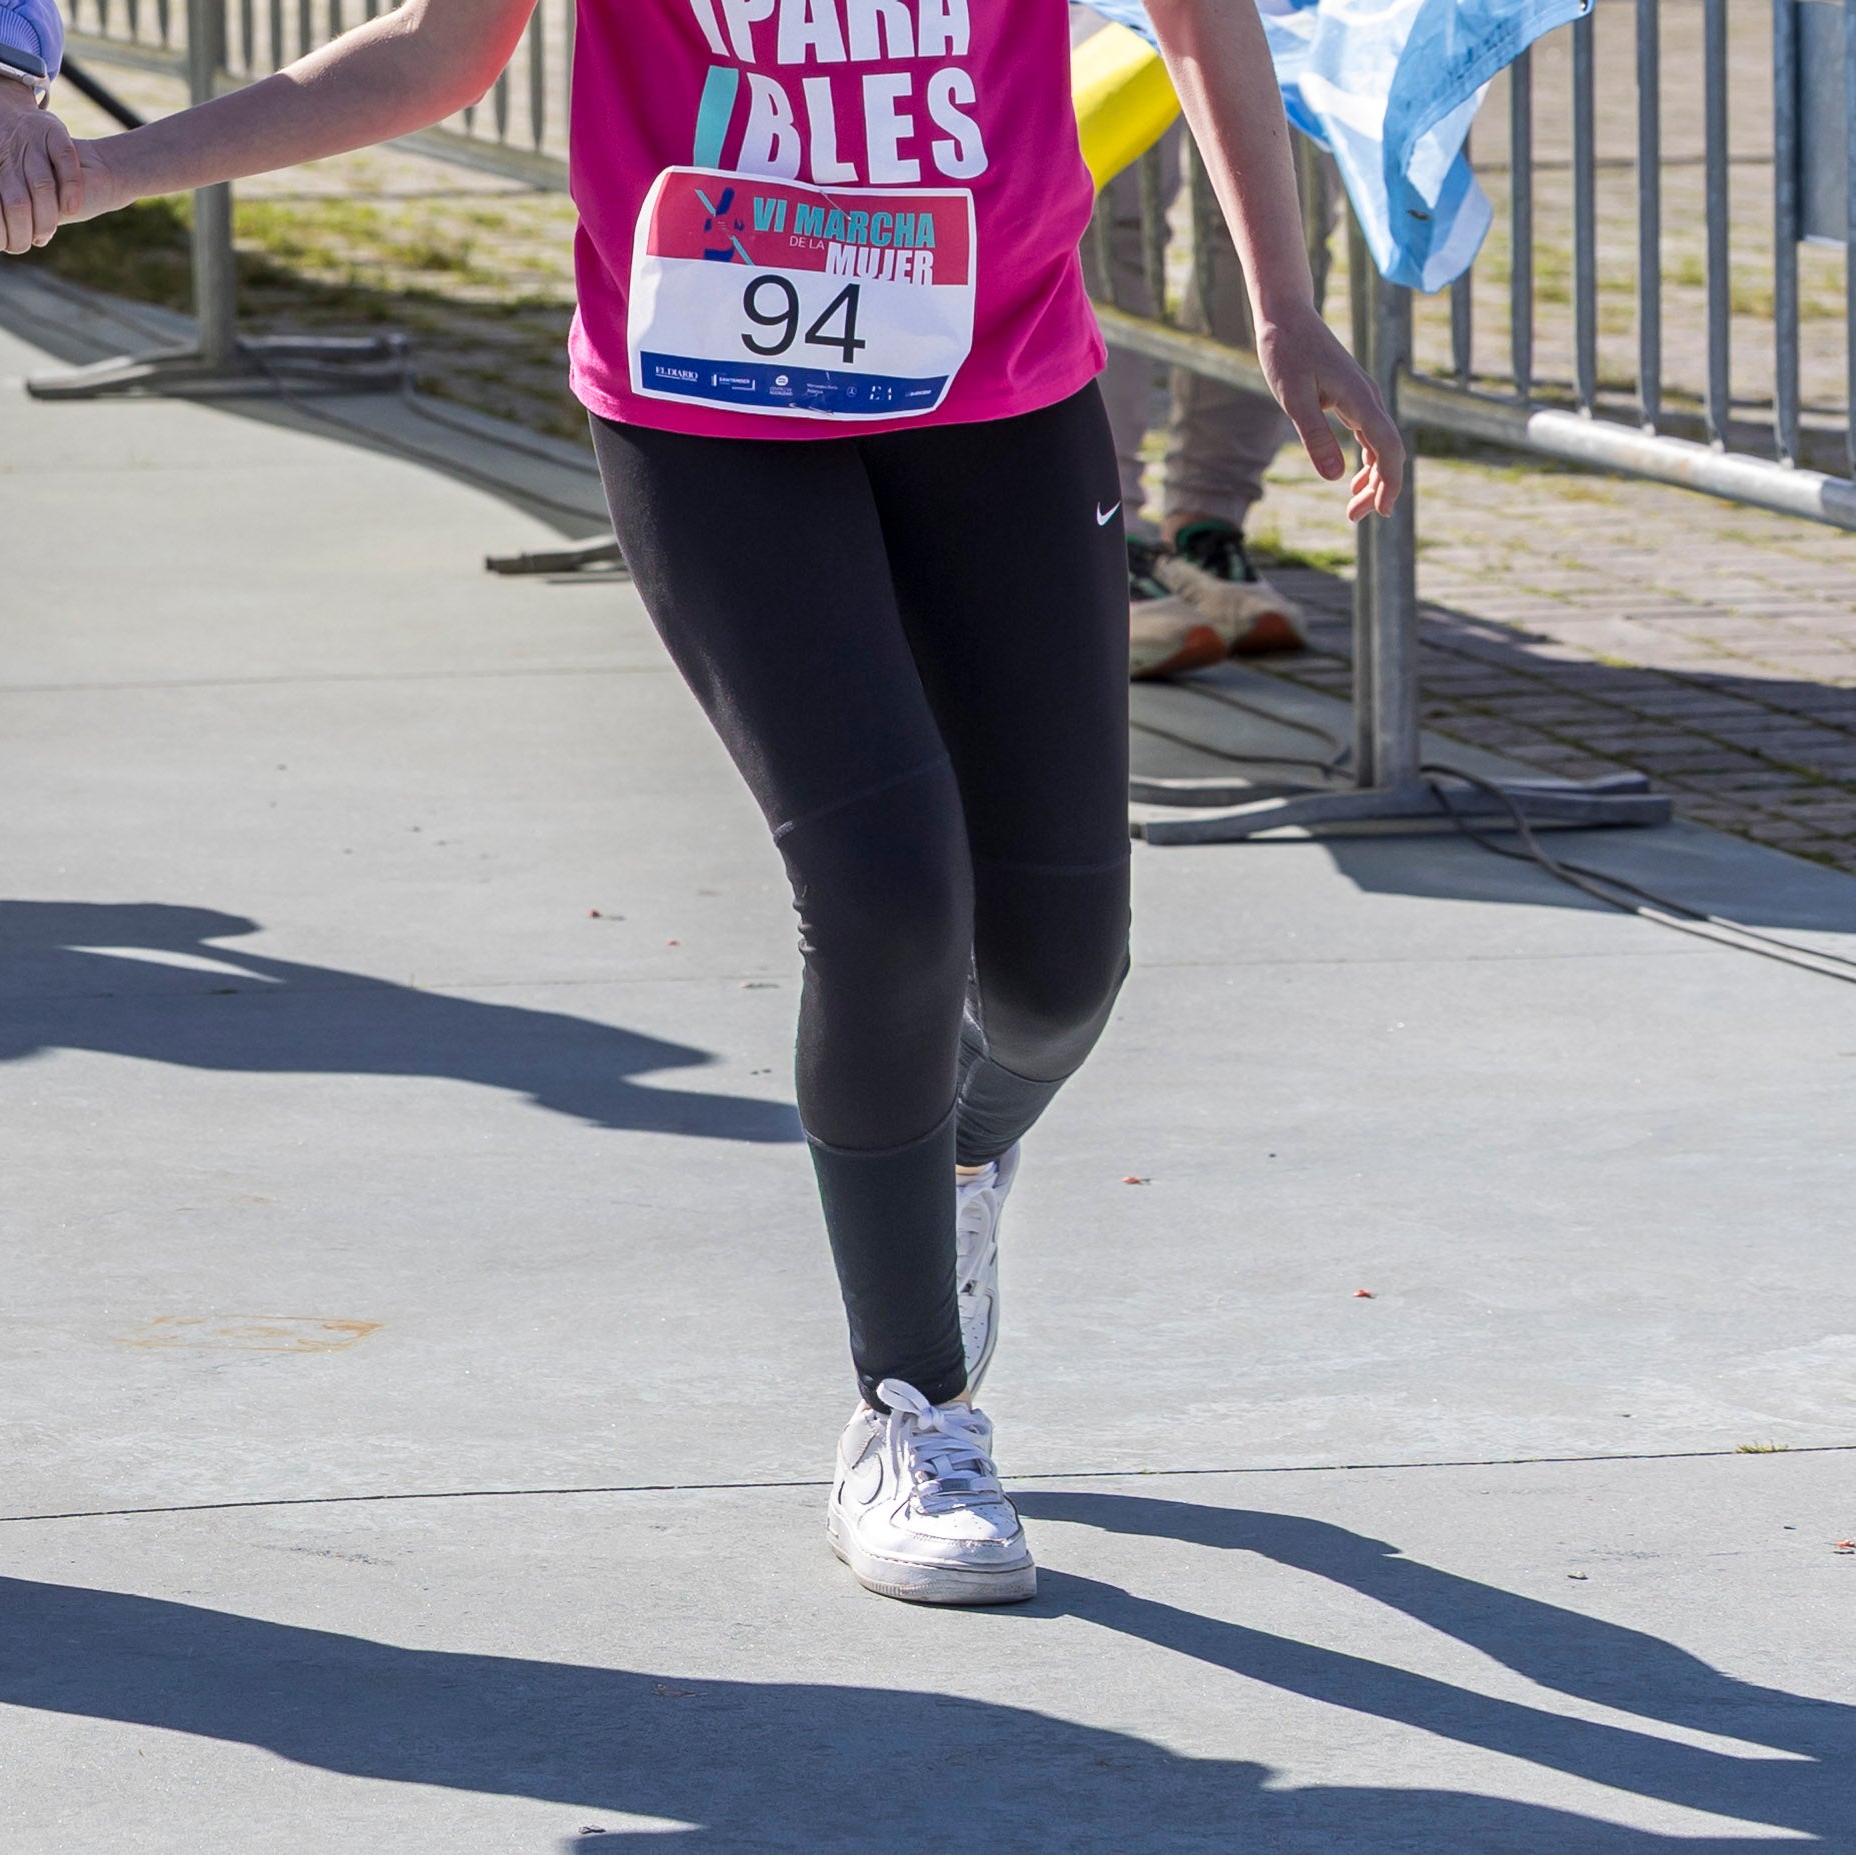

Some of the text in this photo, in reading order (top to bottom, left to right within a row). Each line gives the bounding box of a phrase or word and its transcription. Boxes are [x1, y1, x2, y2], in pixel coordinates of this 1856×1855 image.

[693, 65, 988, 185] IBLES
[753, 196, 936, 249] VI MARCHA
[789, 235, 935, 286] DE LA MUJER
[740, 274, 866, 364] 94
